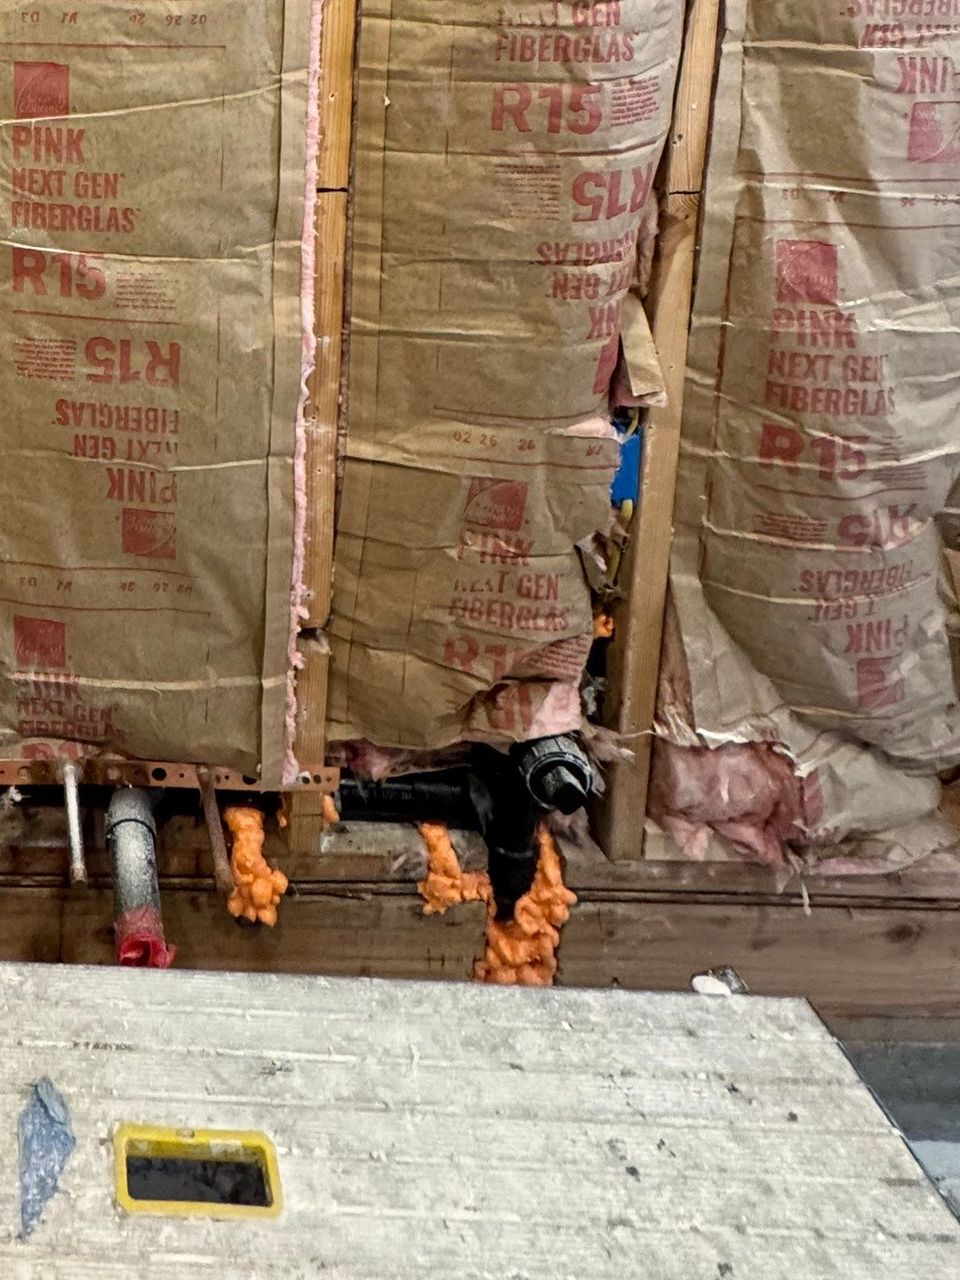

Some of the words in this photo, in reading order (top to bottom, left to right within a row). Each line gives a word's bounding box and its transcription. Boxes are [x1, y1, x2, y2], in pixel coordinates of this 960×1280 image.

[21, 11, 40, 25] D3
[190, 14, 208, 26] 02
[494, 30, 635, 64] FIBERGLAS
[490, 81, 603, 136] R15
[11, 125, 86, 164] PINK
[11, 167, 66, 198] NEXT
[73, 170, 119, 199] GEN
[11, 201, 135, 234] FIBERGLAS
[11, 247, 107, 302] R15
[551, 272, 601, 301] GEN
[771, 307, 858, 349] PINK
[84, 336, 182, 387] R15
[767, 349, 835, 378] NEXT
[764, 380, 896, 416] FIBERGLAS
[55, 398, 180, 435] FIBERGLAS
[73, 433, 117, 460] GEN
[758, 422, 870, 482] R15
[105, 467, 178, 505] PINK
[516, 572, 559, 602] GEN
